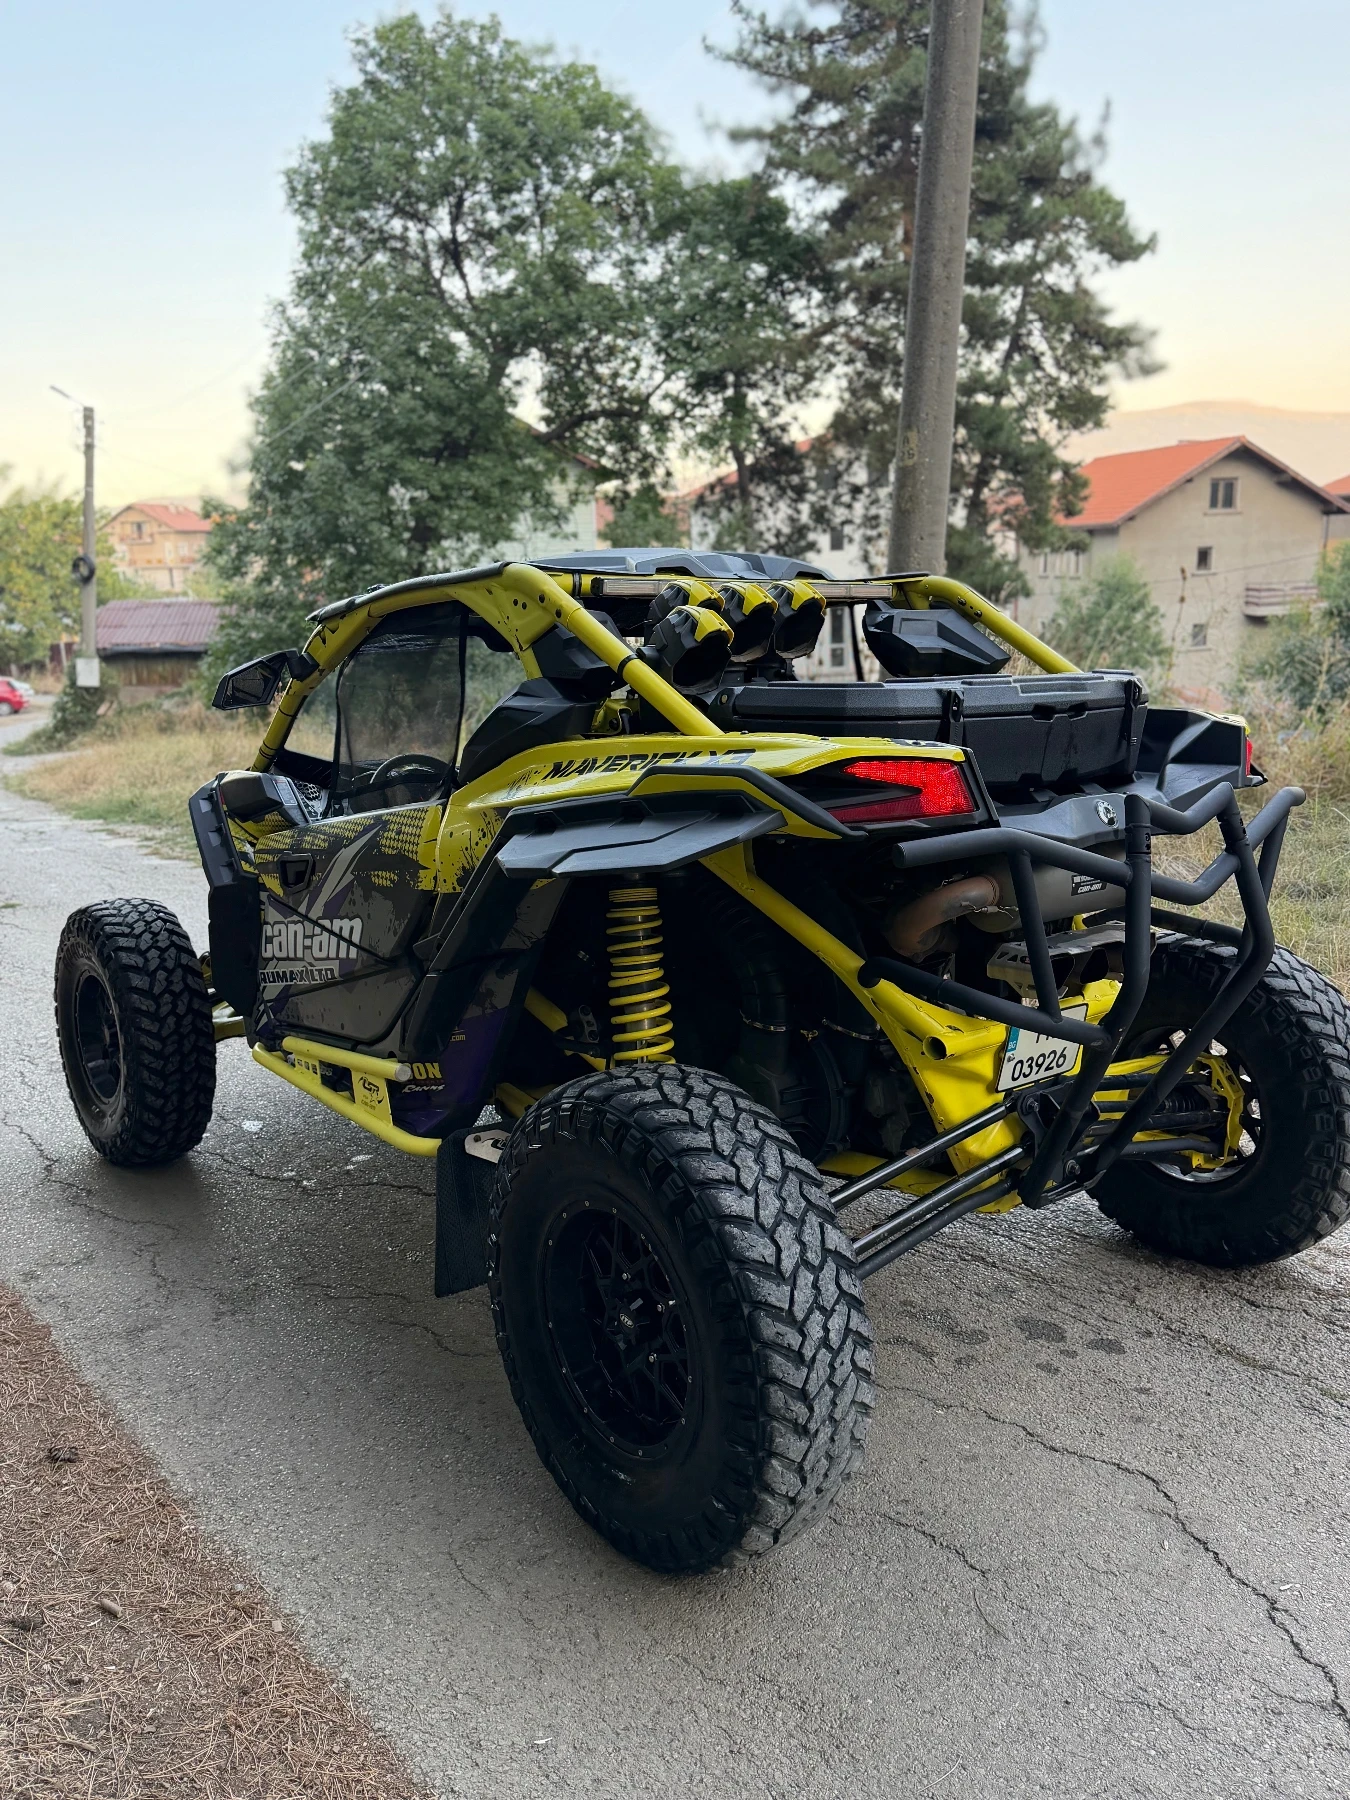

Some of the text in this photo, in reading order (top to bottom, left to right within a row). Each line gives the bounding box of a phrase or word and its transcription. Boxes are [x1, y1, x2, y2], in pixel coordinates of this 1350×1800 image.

[541, 750, 703, 781] MAVERICK
[261, 917, 362, 960] can-am
[309, 966, 338, 982] LTD
[1008, 1040, 1017, 1050] BG
[1011, 1046, 1068, 1082] 03926
